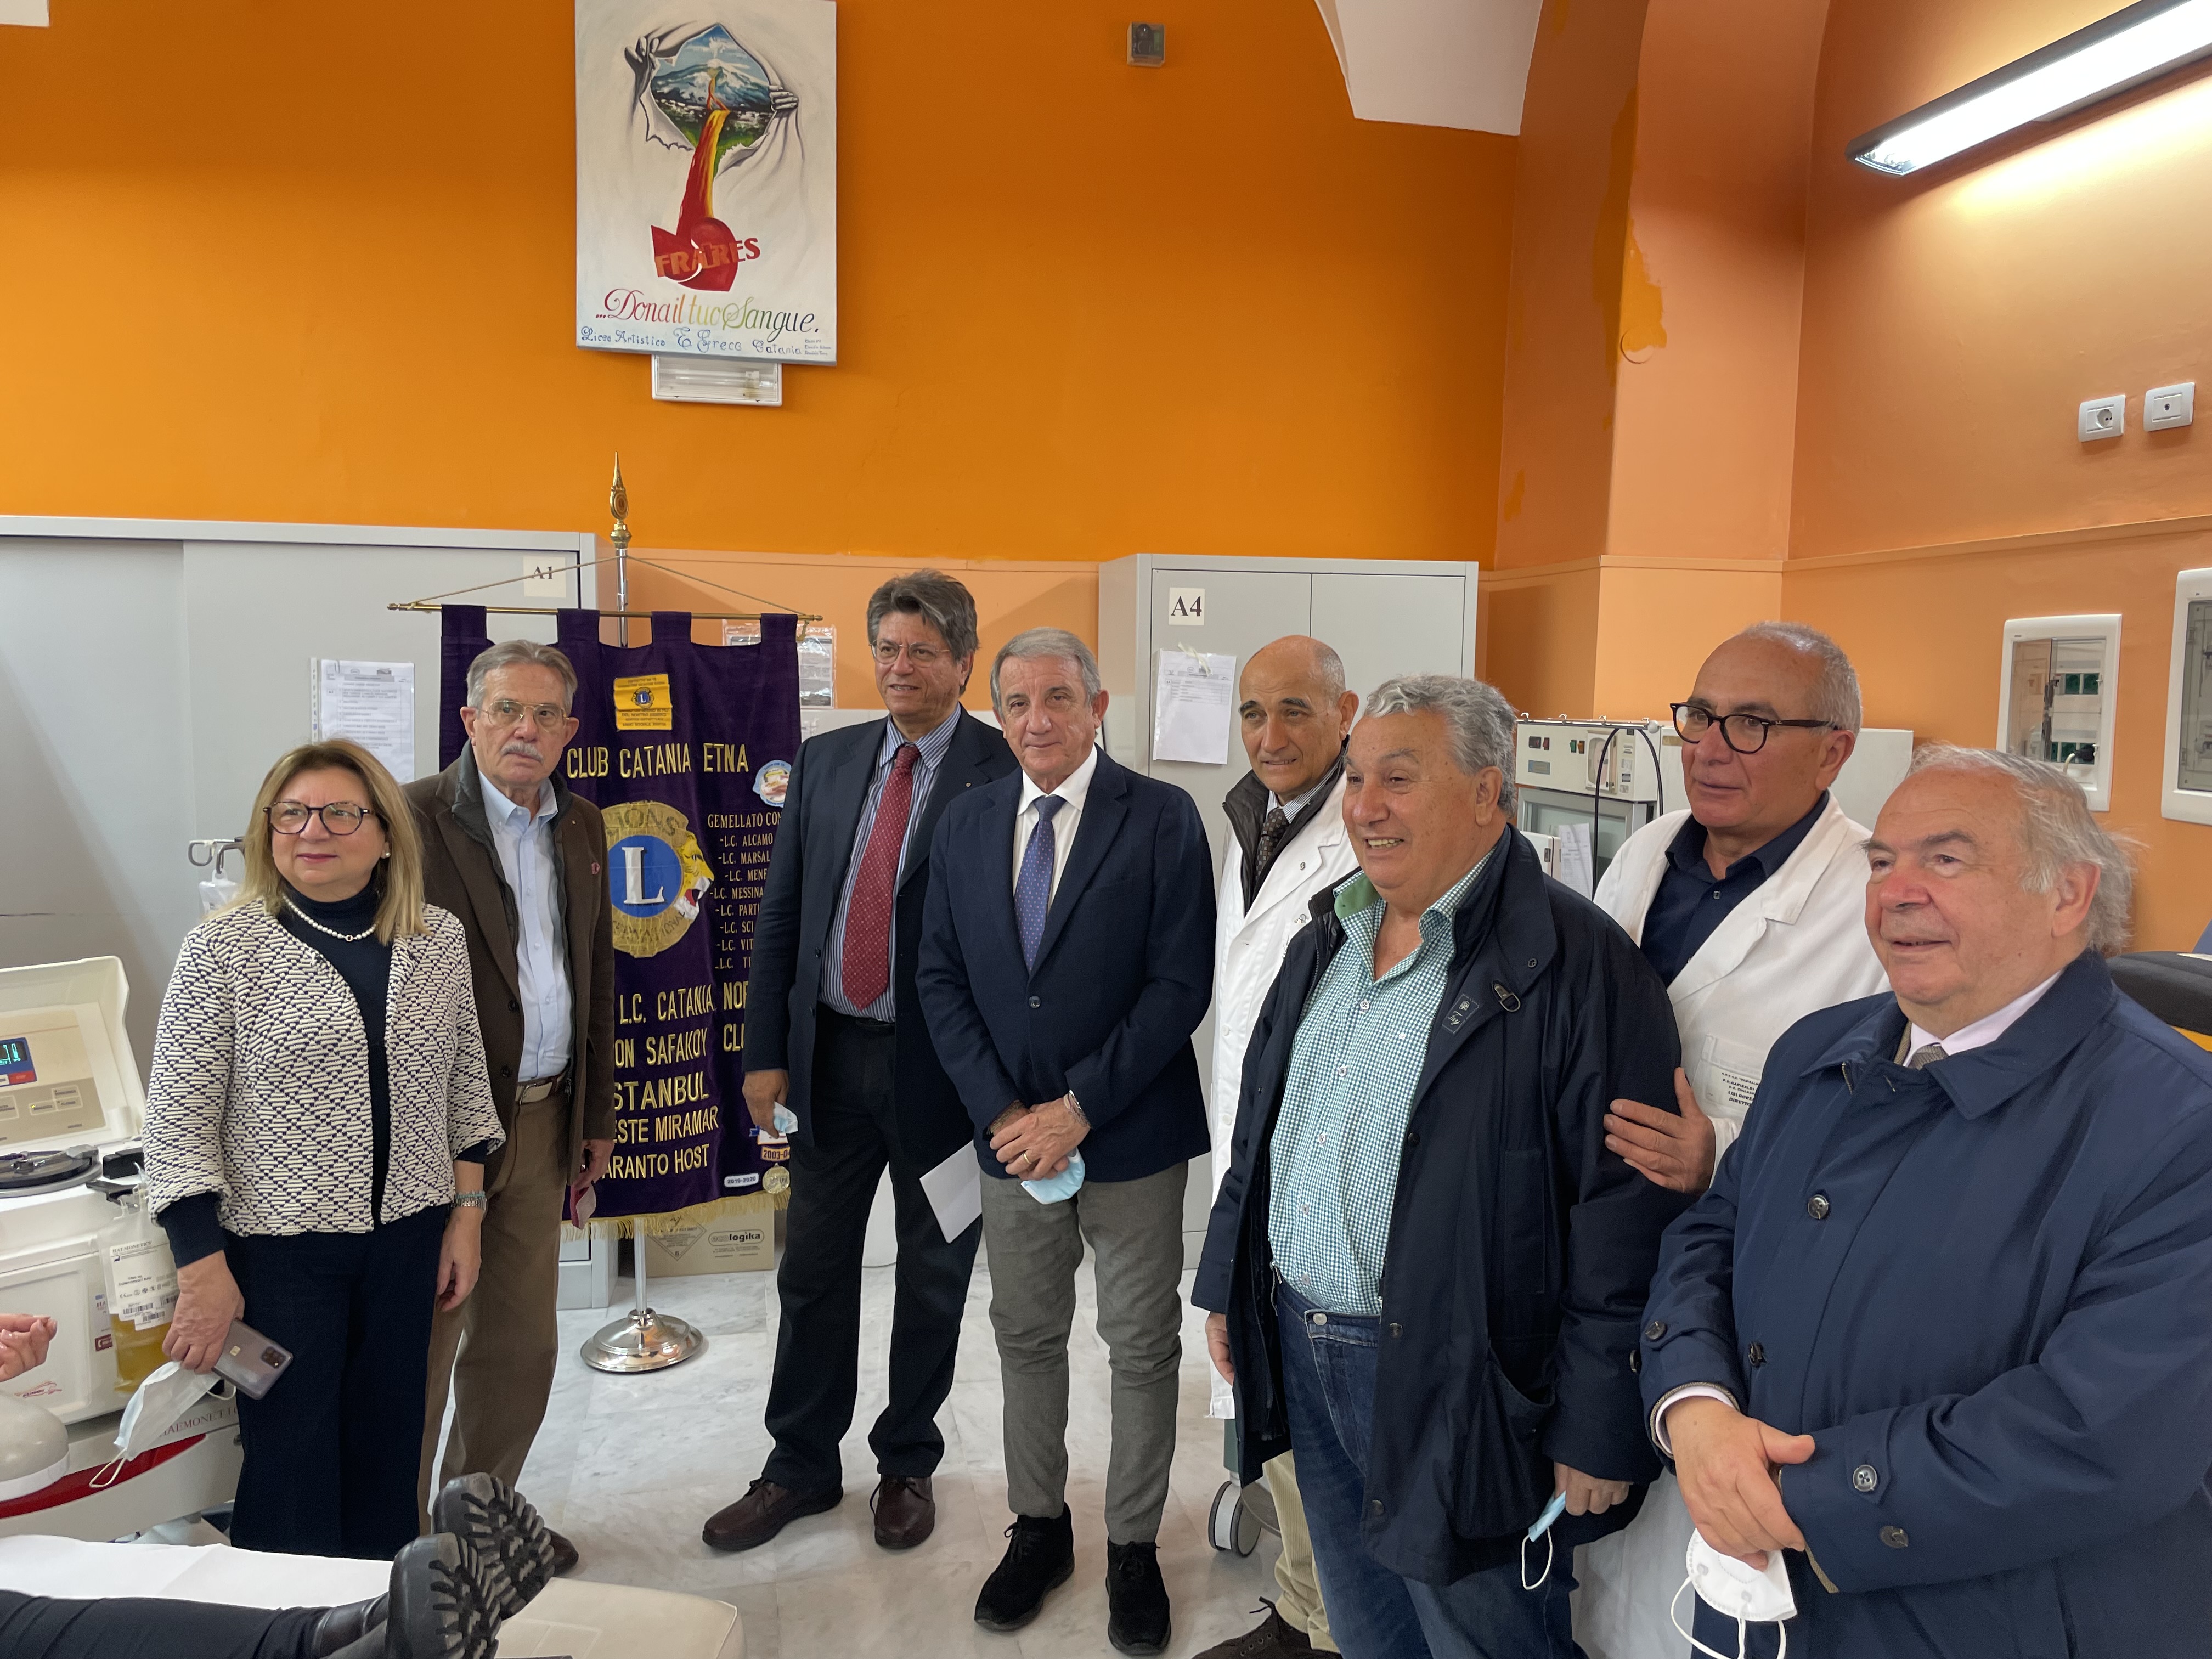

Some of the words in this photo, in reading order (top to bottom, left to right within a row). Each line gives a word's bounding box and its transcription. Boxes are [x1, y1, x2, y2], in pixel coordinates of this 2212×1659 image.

[689, 295, 723, 325] tuo
[723, 296, 819, 343] Sangue.
[581, 326, 611, 342] Liceo
[614, 330, 665, 346] Artistico
[697, 329, 742, 353] Greco
[752, 339, 802, 354] Catania
[531, 566, 554, 579] A1
[1171, 595, 1203, 617] A4
[567, 746, 608, 778] CLUB
[619, 743, 691, 778] CATANIA
[703, 742, 749, 773] ETNA
[707, 813, 763, 828] GEMELLATO
[742, 833, 773, 847] ALCAMO
[741, 850, 770, 864] MARSAL
[622, 847, 665, 904] L
[747, 868, 767, 881] MENF
[731, 886, 764, 899] MESSINA
[742, 921, 754, 933] SCI
[741, 938, 753, 951] VIT
[620, 993, 646, 1024] L.C.
[657, 984, 714, 1022] CATANIA
[614, 1039, 635, 1068] ON
[646, 1027, 708, 1066] SAFAKOY
[614, 1071, 709, 1111] STANBUL
[655, 1105, 719, 1142] MIRAMAR
[602, 1153, 669, 1178] ARANTO
[675, 1143, 710, 1174] HOST
[763, 1149, 790, 1160] 2003-0
